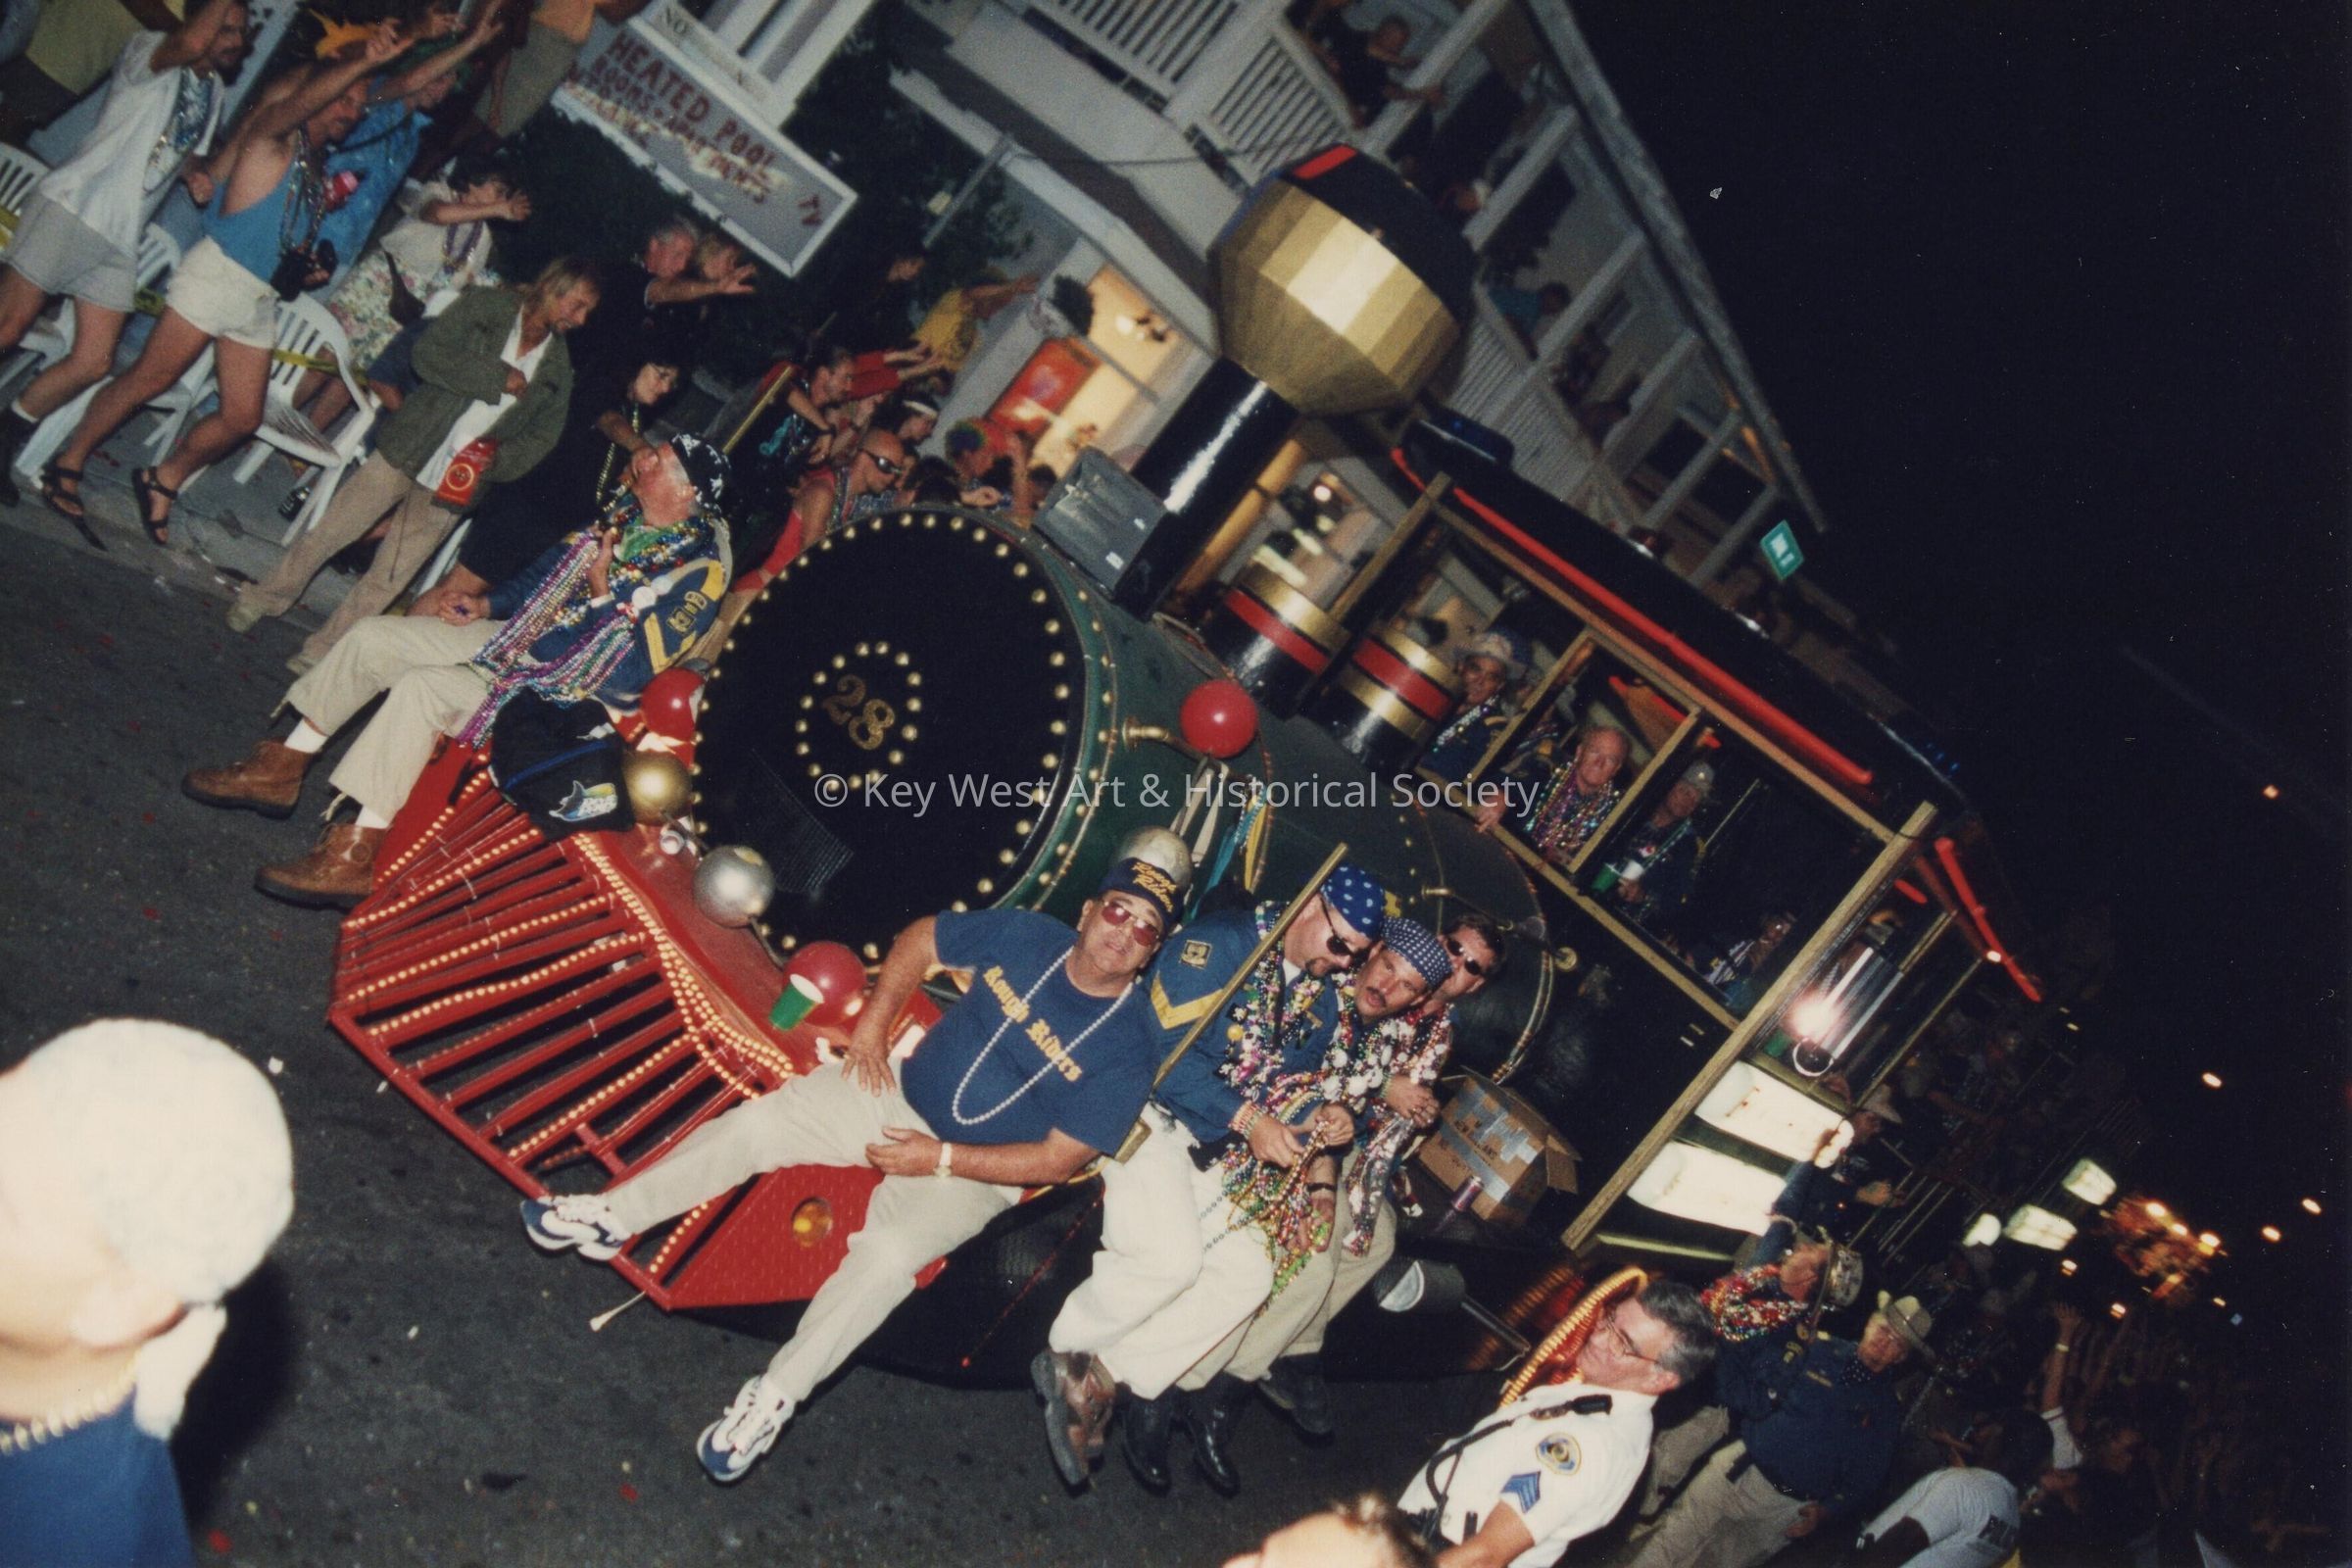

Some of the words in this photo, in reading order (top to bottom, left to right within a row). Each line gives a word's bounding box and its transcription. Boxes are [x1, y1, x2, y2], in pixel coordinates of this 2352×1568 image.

[590, 55, 655, 116] ROOMS
[606, 30, 711, 122] HEATED
[714, 119, 777, 180] POOL
[797, 194, 823, 226] TV
[821, 673, 896, 751] 28
[983, 964, 1030, 1023] Rough
[1024, 1018, 1083, 1082] Riders
